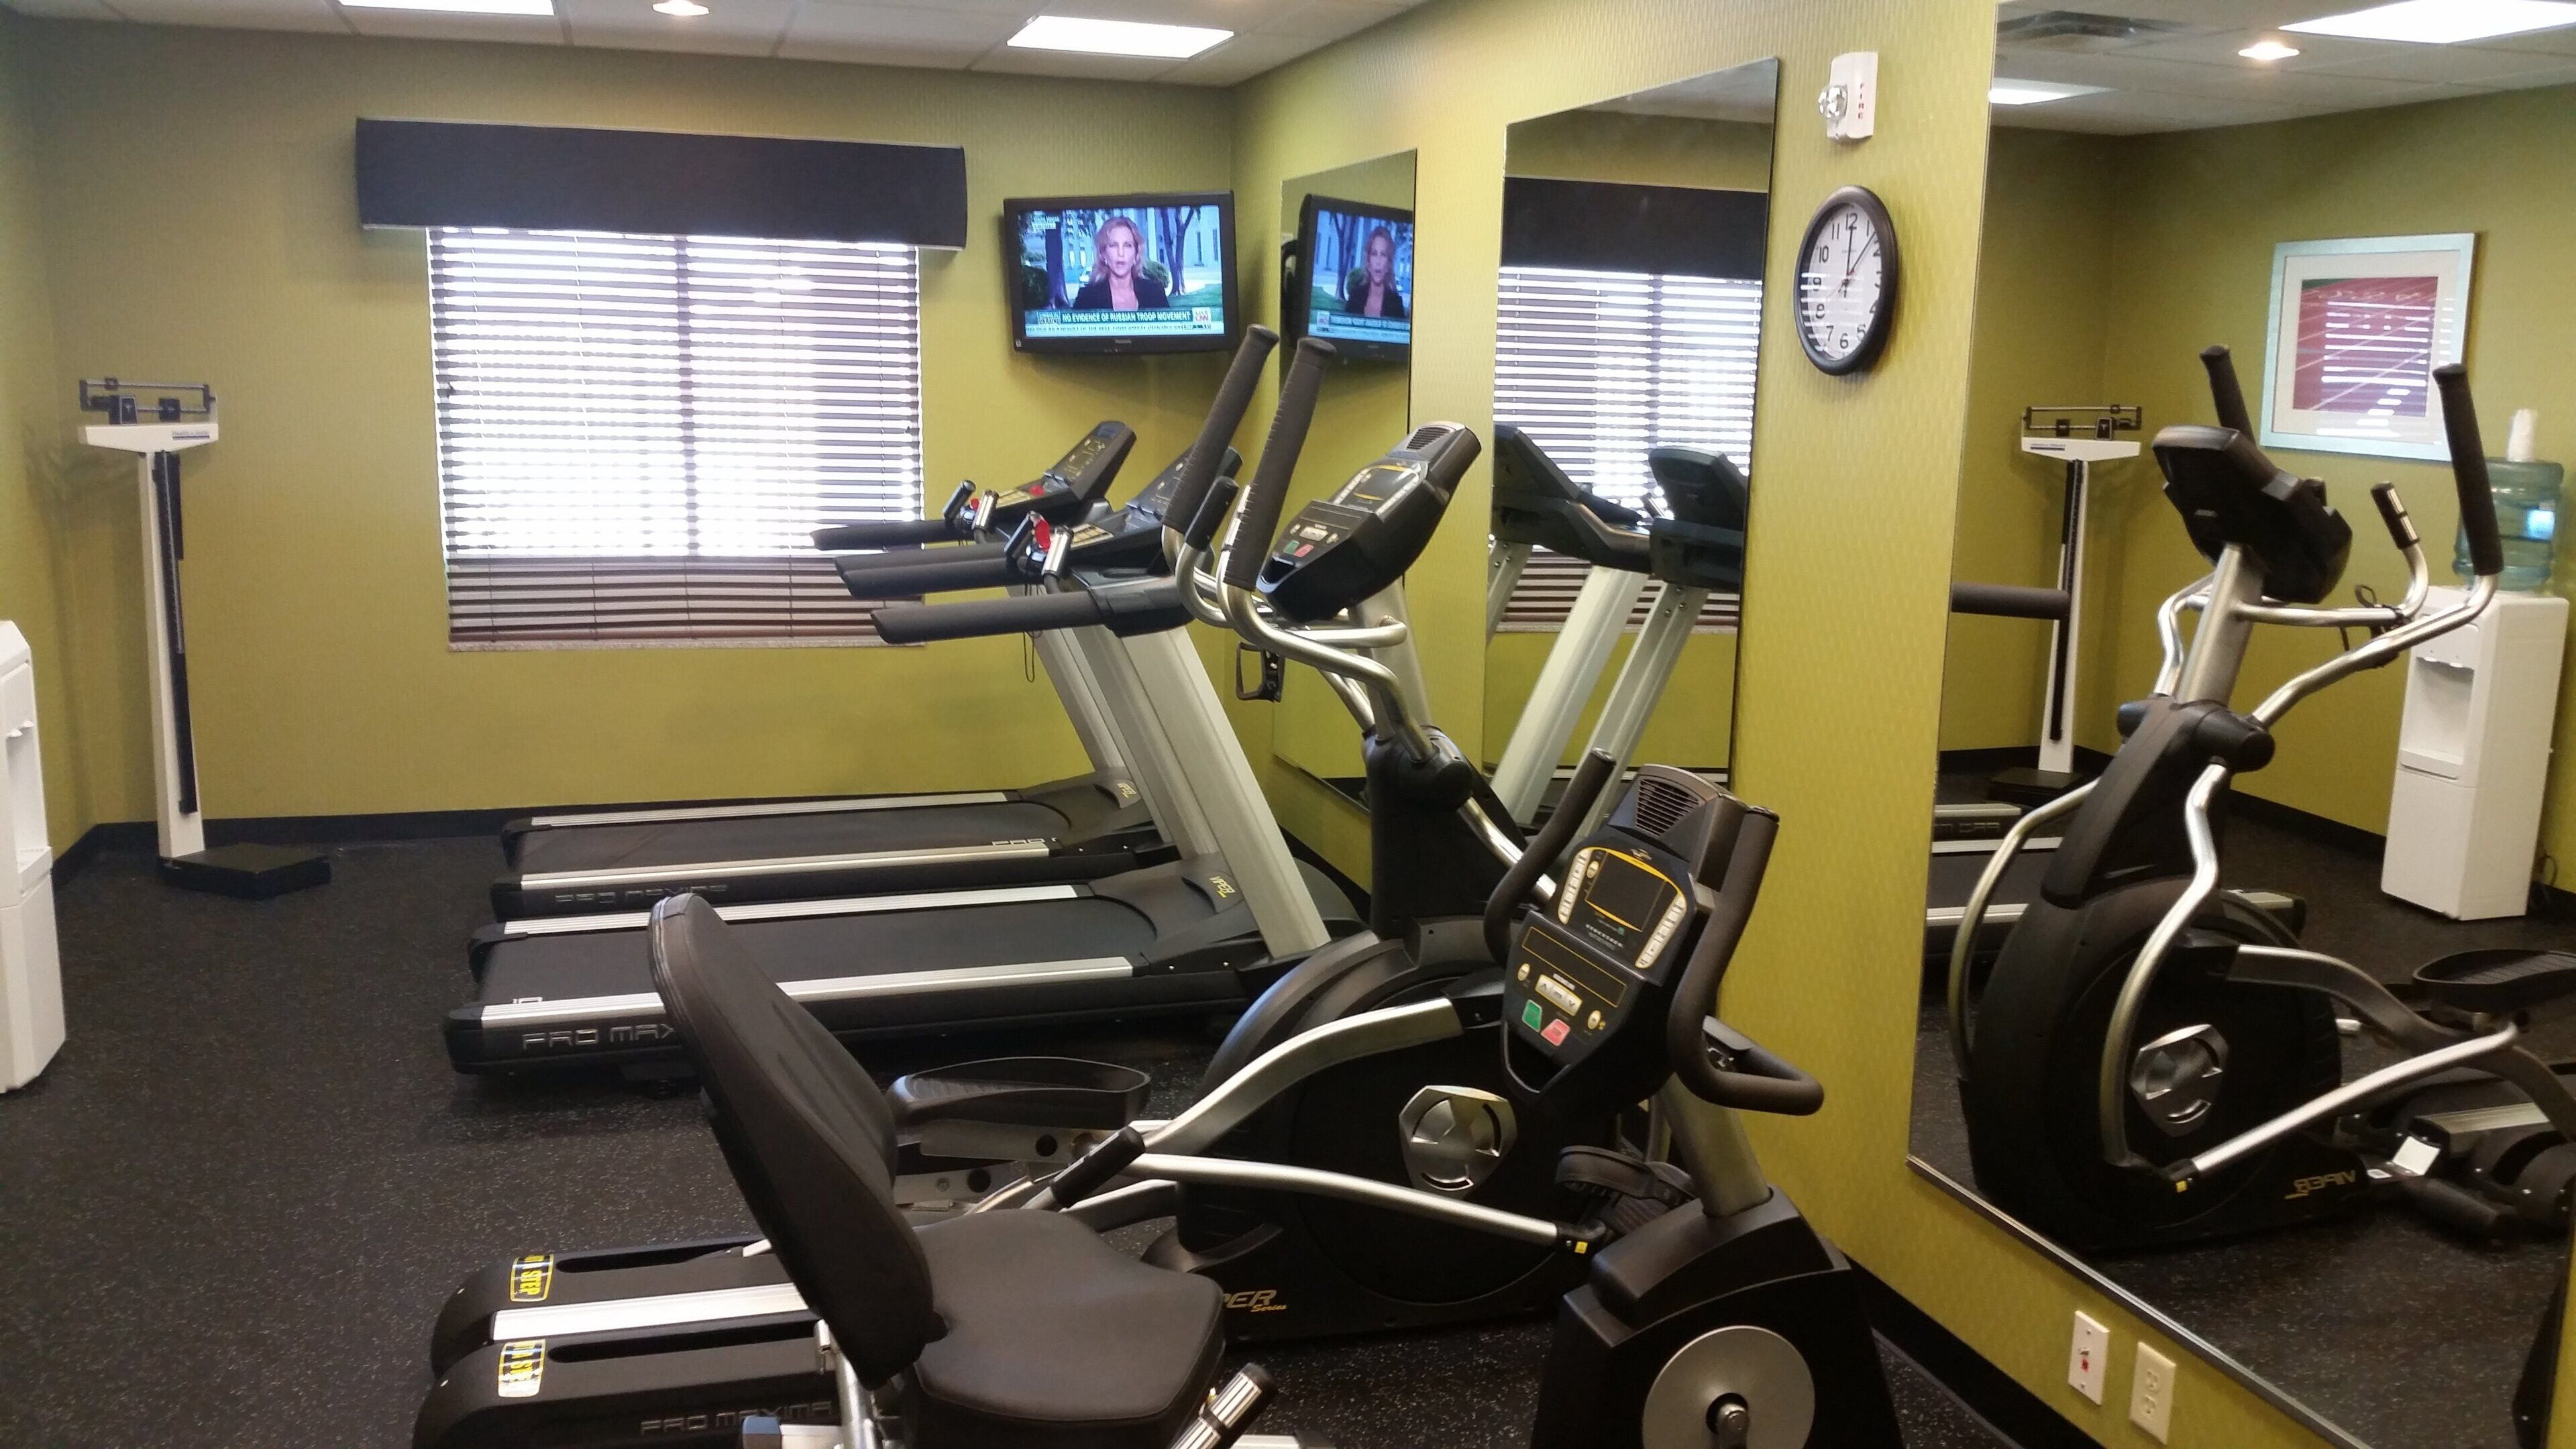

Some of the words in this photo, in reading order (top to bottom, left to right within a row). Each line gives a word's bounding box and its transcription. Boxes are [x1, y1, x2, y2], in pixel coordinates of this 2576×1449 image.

[1845, 213, 1858, 231] 12
[1831, 223, 1839, 240] 11
[1819, 246, 1829, 263] 10
[1062, 313, 1071, 322] NO
[1073, 313, 1100, 322] EVIDENCE
[1101, 313, 1110, 321] OF
[1110, 312, 1136, 321] RUSSIAN
[1137, 311, 1157, 321] TROOP
[1157, 311, 1191, 321] MOVEMENT
[1826, 325, 1833, 341] 7
[1857, 323, 1866, 341] 5
[1840, 333, 1849, 349] 6
[523, 1028, 598, 1050] PRO
[519, 1269, 543, 1296] STEP
[641, 1414, 708, 1435] PRO
